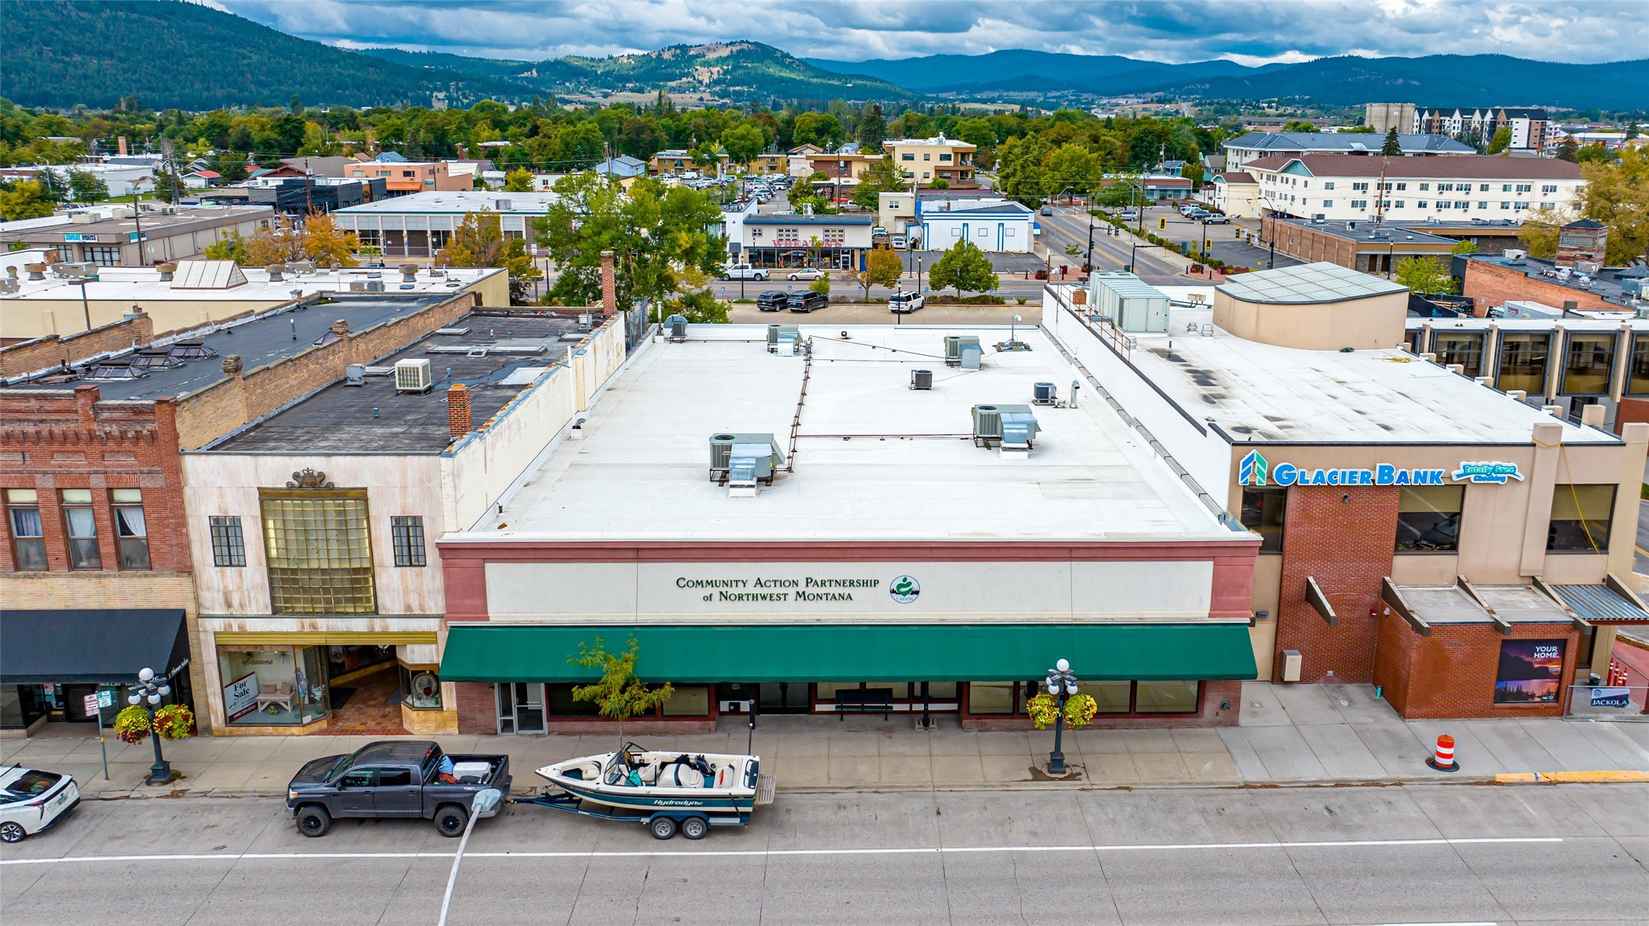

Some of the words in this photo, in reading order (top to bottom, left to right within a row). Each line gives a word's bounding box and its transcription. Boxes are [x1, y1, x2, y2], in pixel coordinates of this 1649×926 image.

[1273, 463, 1373, 486] GLACIER
[1375, 463, 1445, 486] BANK
[676, 577, 748, 588] COMMUNITY
[754, 577, 799, 588] ACTION
[805, 577, 880, 588] PARTNERSHIP
[703, 593, 713, 602] of
[719, 591, 789, 601] NORTHWEST
[795, 591, 853, 601] MONTANA
[234, 688, 250, 698] Sale
